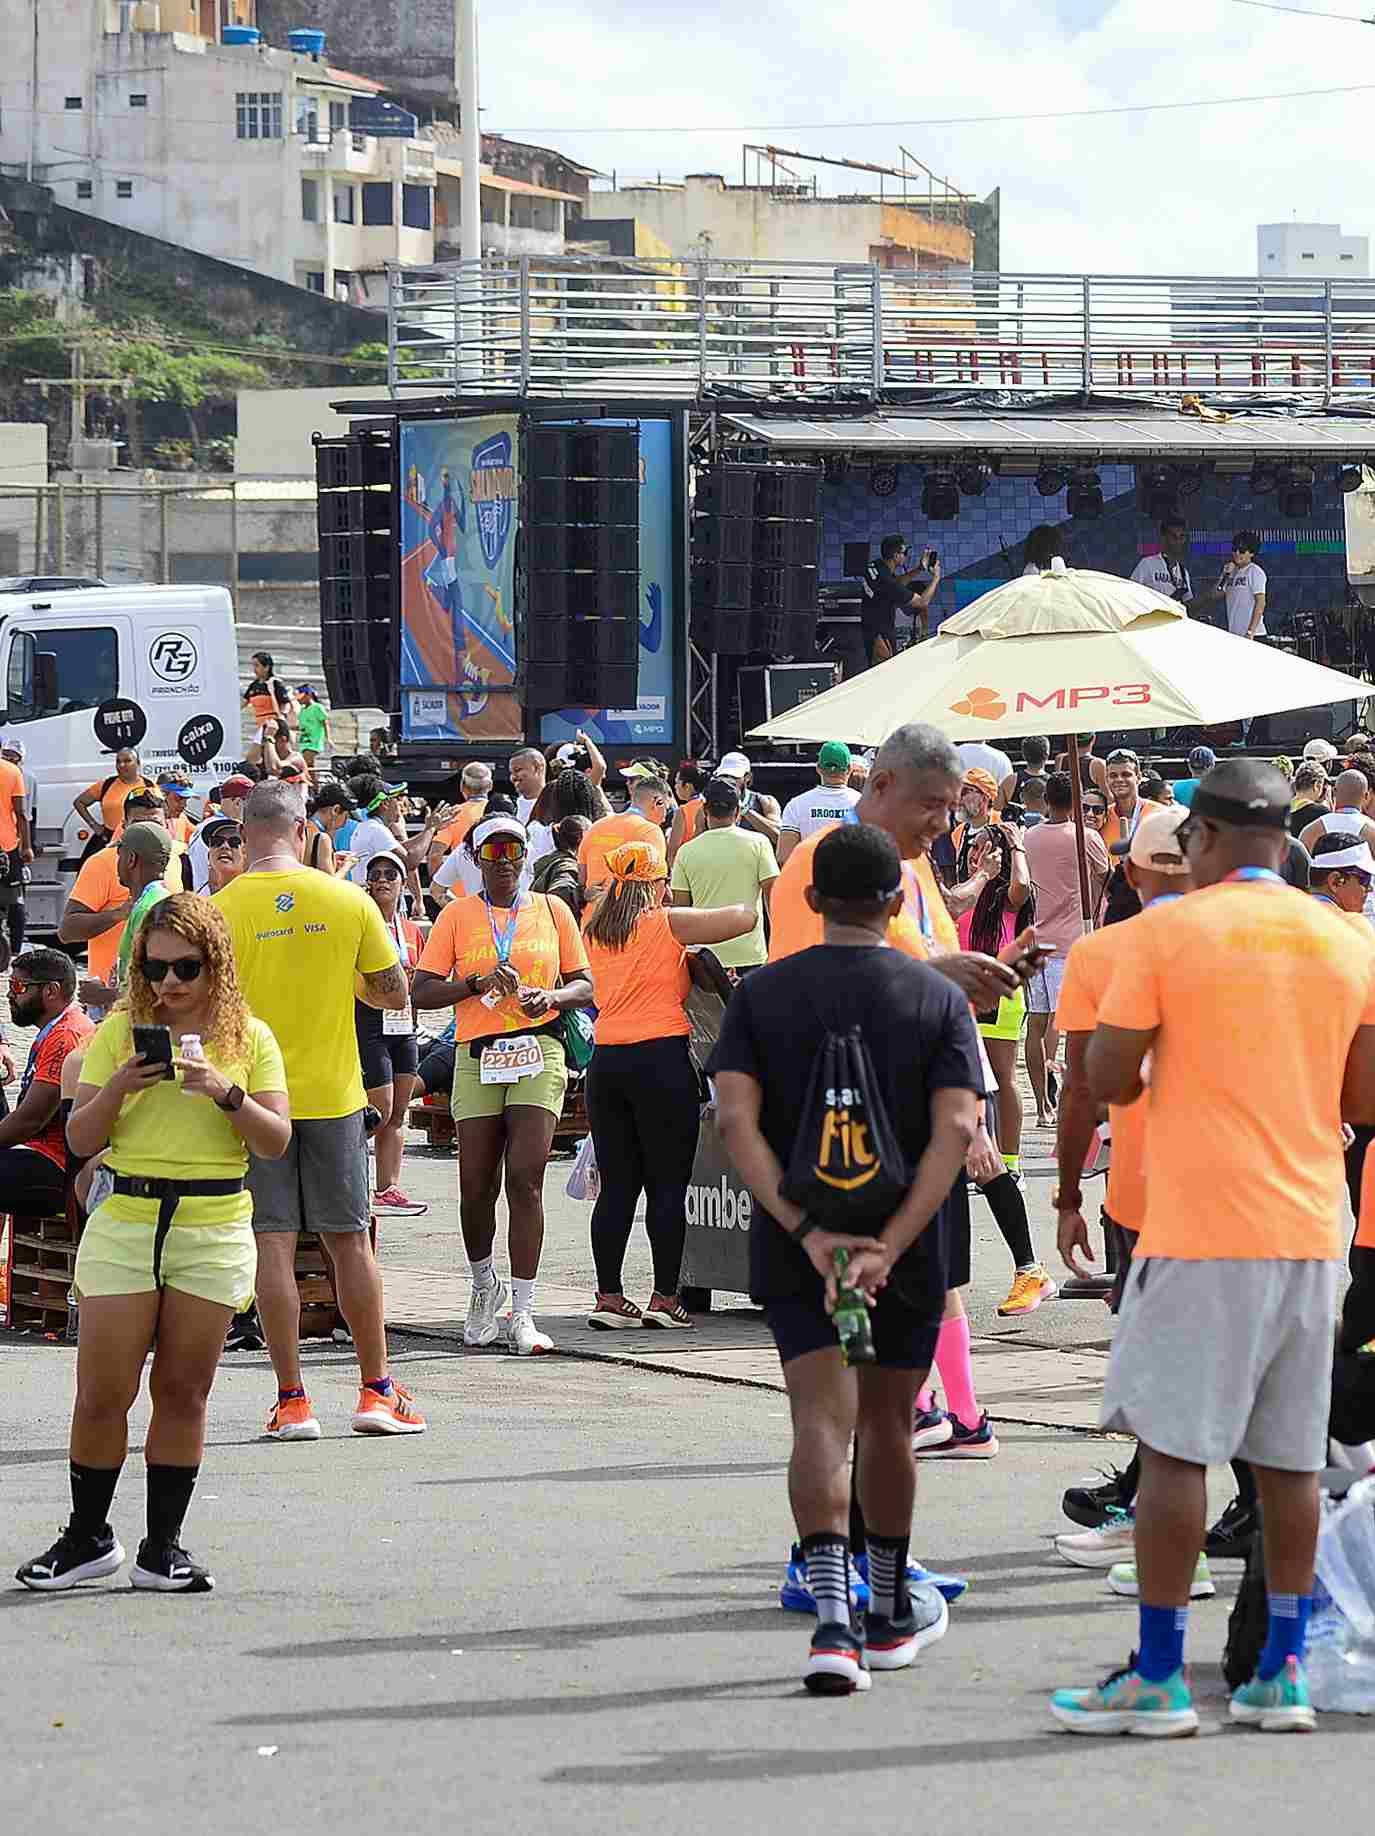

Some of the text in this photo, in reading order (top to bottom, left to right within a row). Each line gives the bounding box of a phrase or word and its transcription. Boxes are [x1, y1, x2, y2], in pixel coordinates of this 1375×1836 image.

[154, 640, 193, 675] RG
[1016, 684, 1152, 712] MP3
[181, 721, 215, 746] caixa
[304, 922, 327, 934] VISA
[484, 1051, 539, 1070] 22760
[818, 1109, 877, 1169] fit
[684, 1174, 753, 1232] ambe
